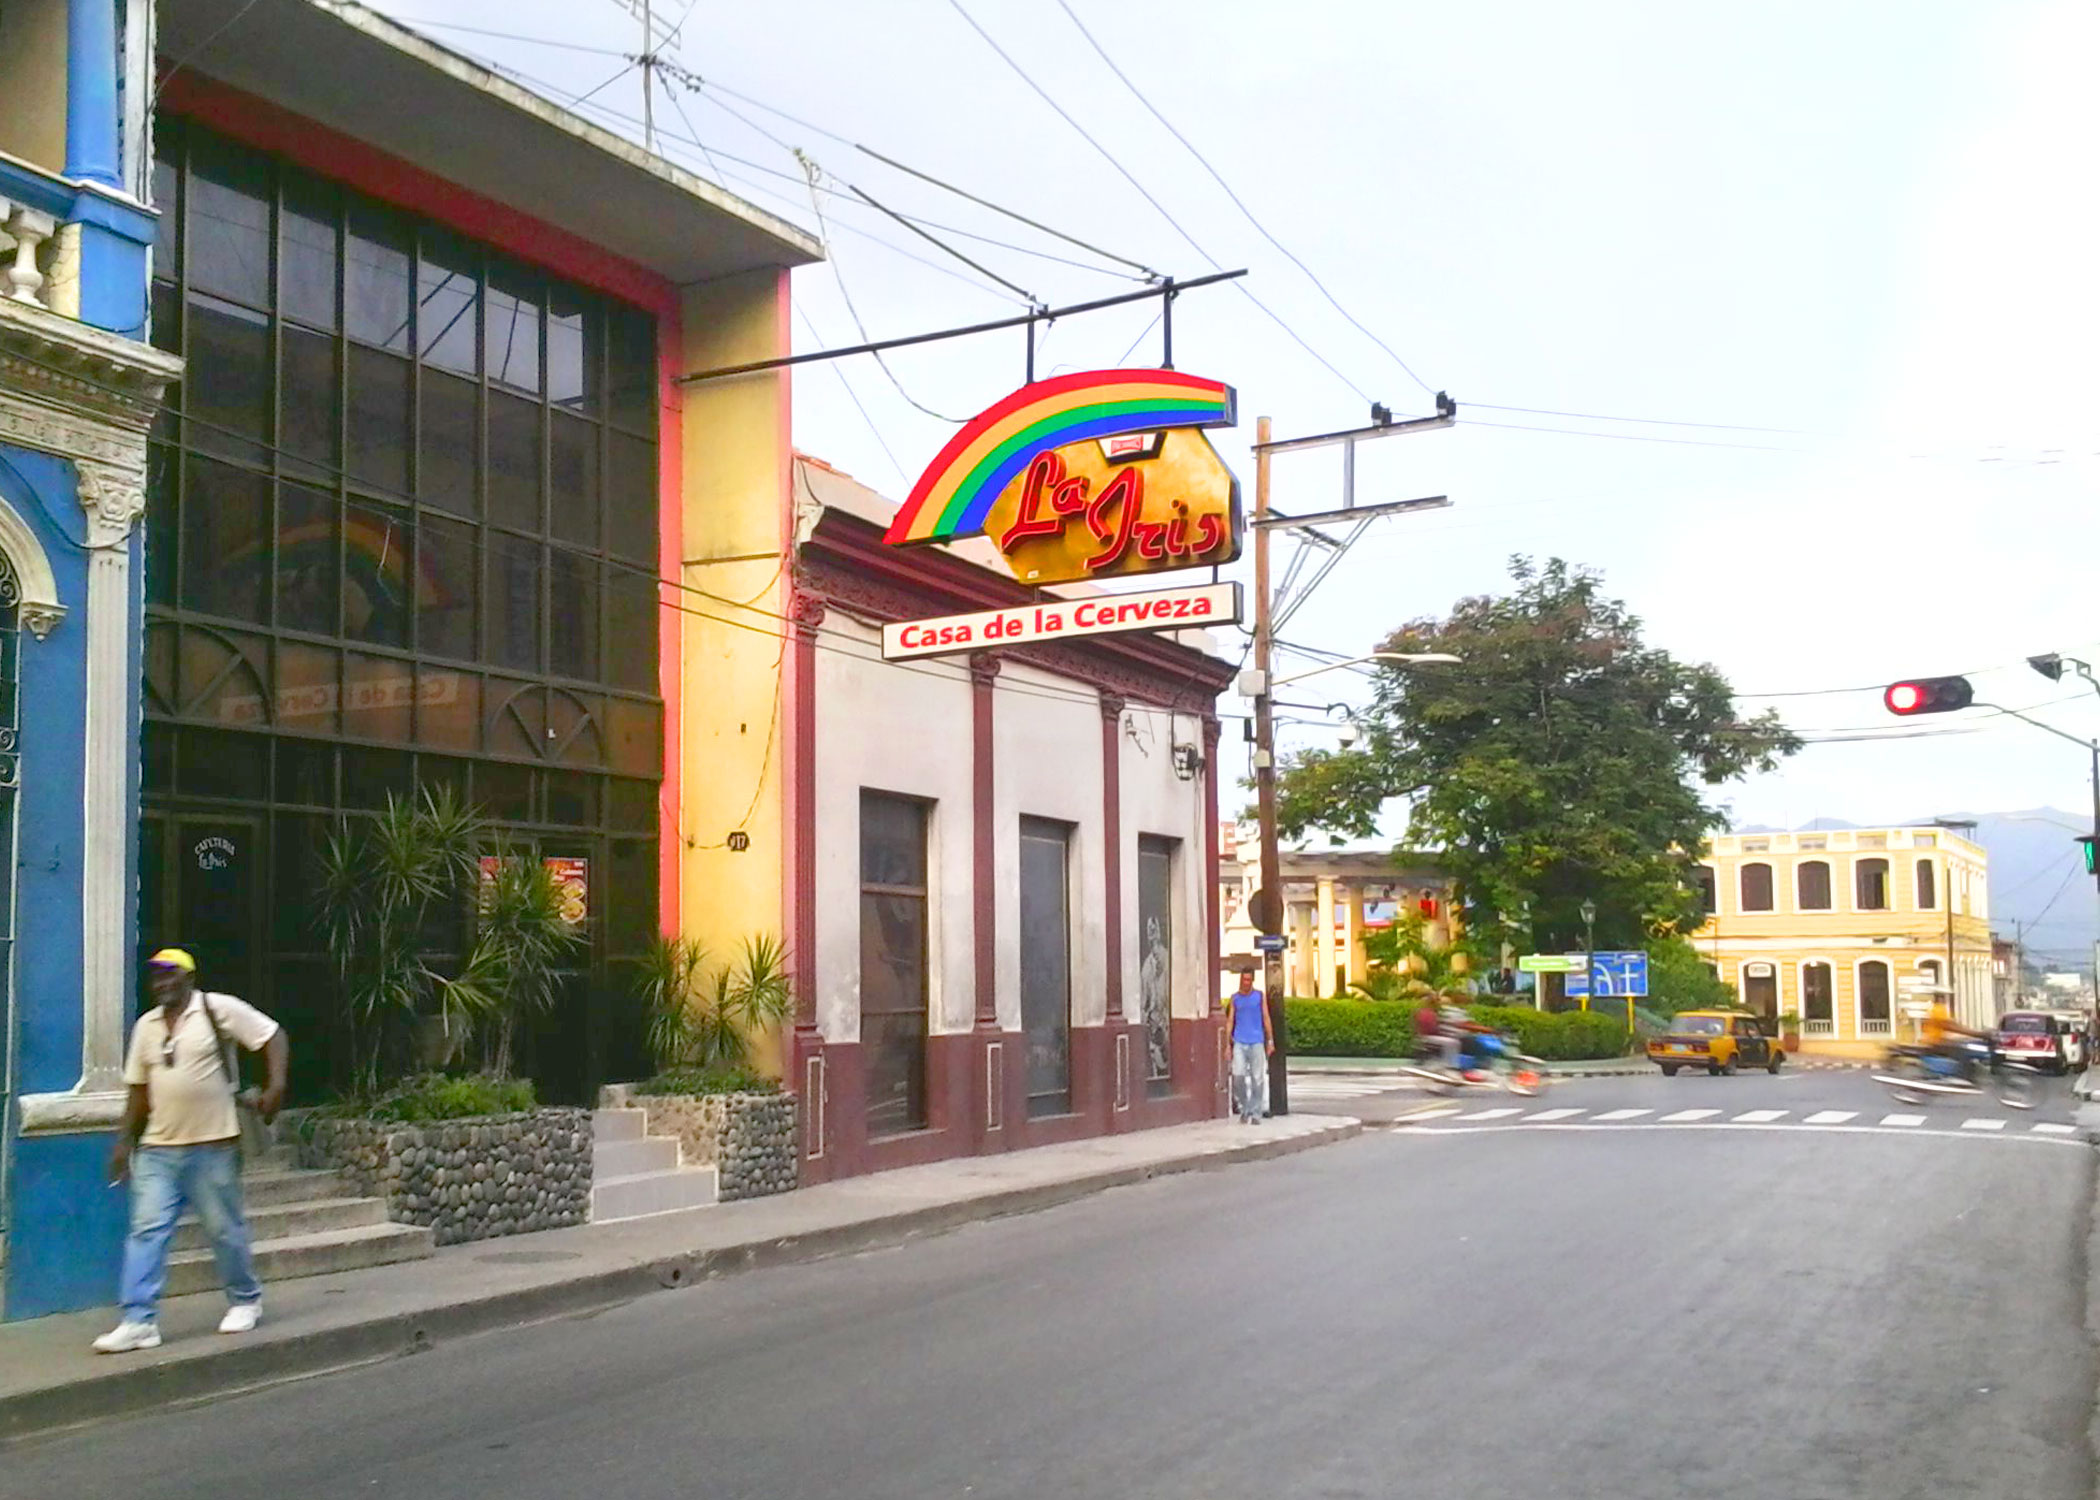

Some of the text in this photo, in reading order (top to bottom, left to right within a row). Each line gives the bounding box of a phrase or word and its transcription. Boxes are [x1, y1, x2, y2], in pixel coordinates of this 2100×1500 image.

[1000, 450, 1225, 571] La Iris
[900, 597, 1211, 648] Casa de la Cerveza
